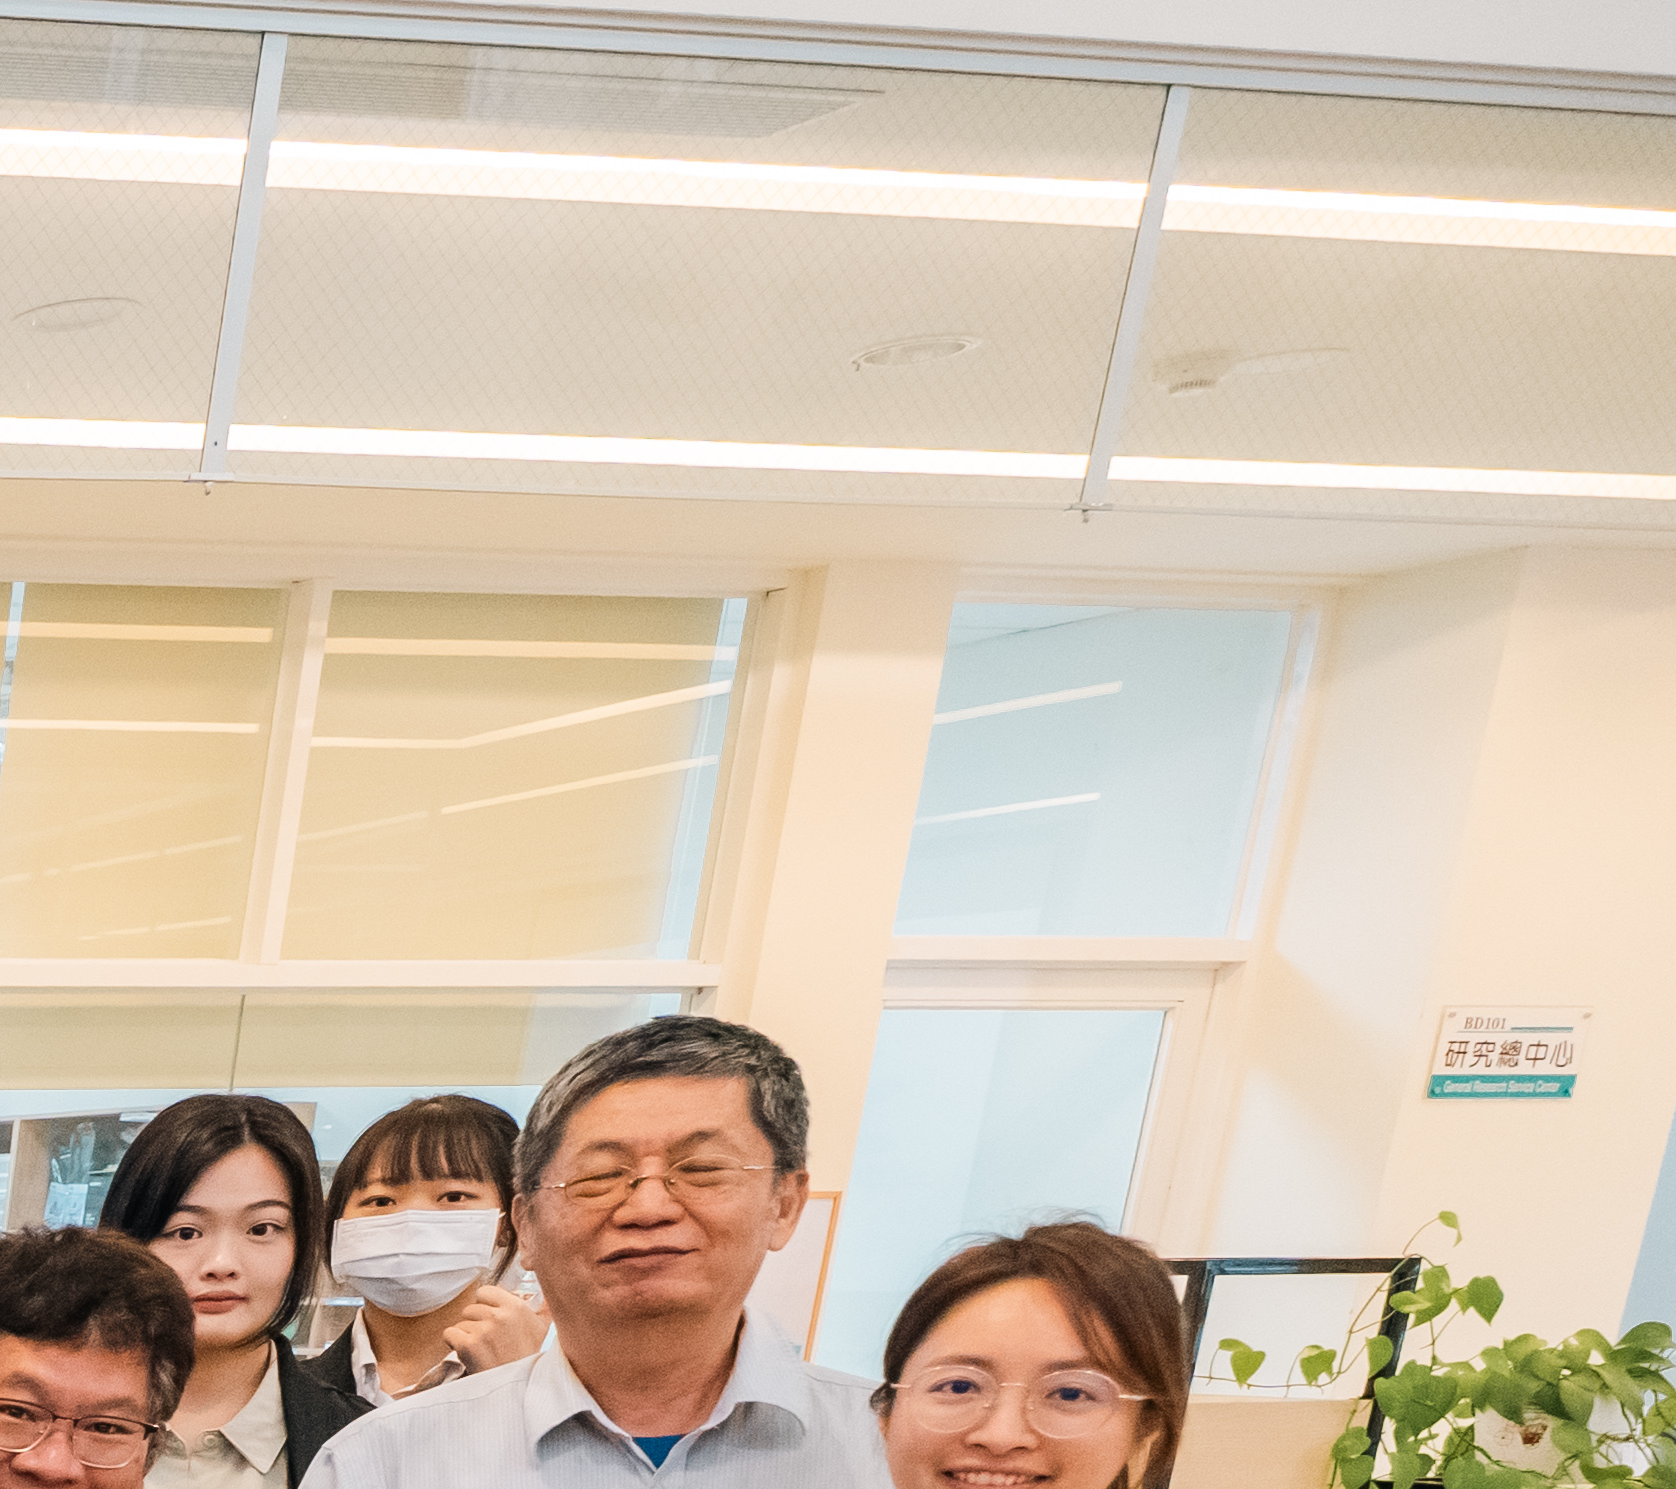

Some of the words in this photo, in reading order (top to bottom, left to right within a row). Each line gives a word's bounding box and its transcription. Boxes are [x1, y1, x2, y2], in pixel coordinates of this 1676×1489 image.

[1463, 1017, 1507, 1030] BD101
[1445, 1040, 1574, 1068] 研究總中心
